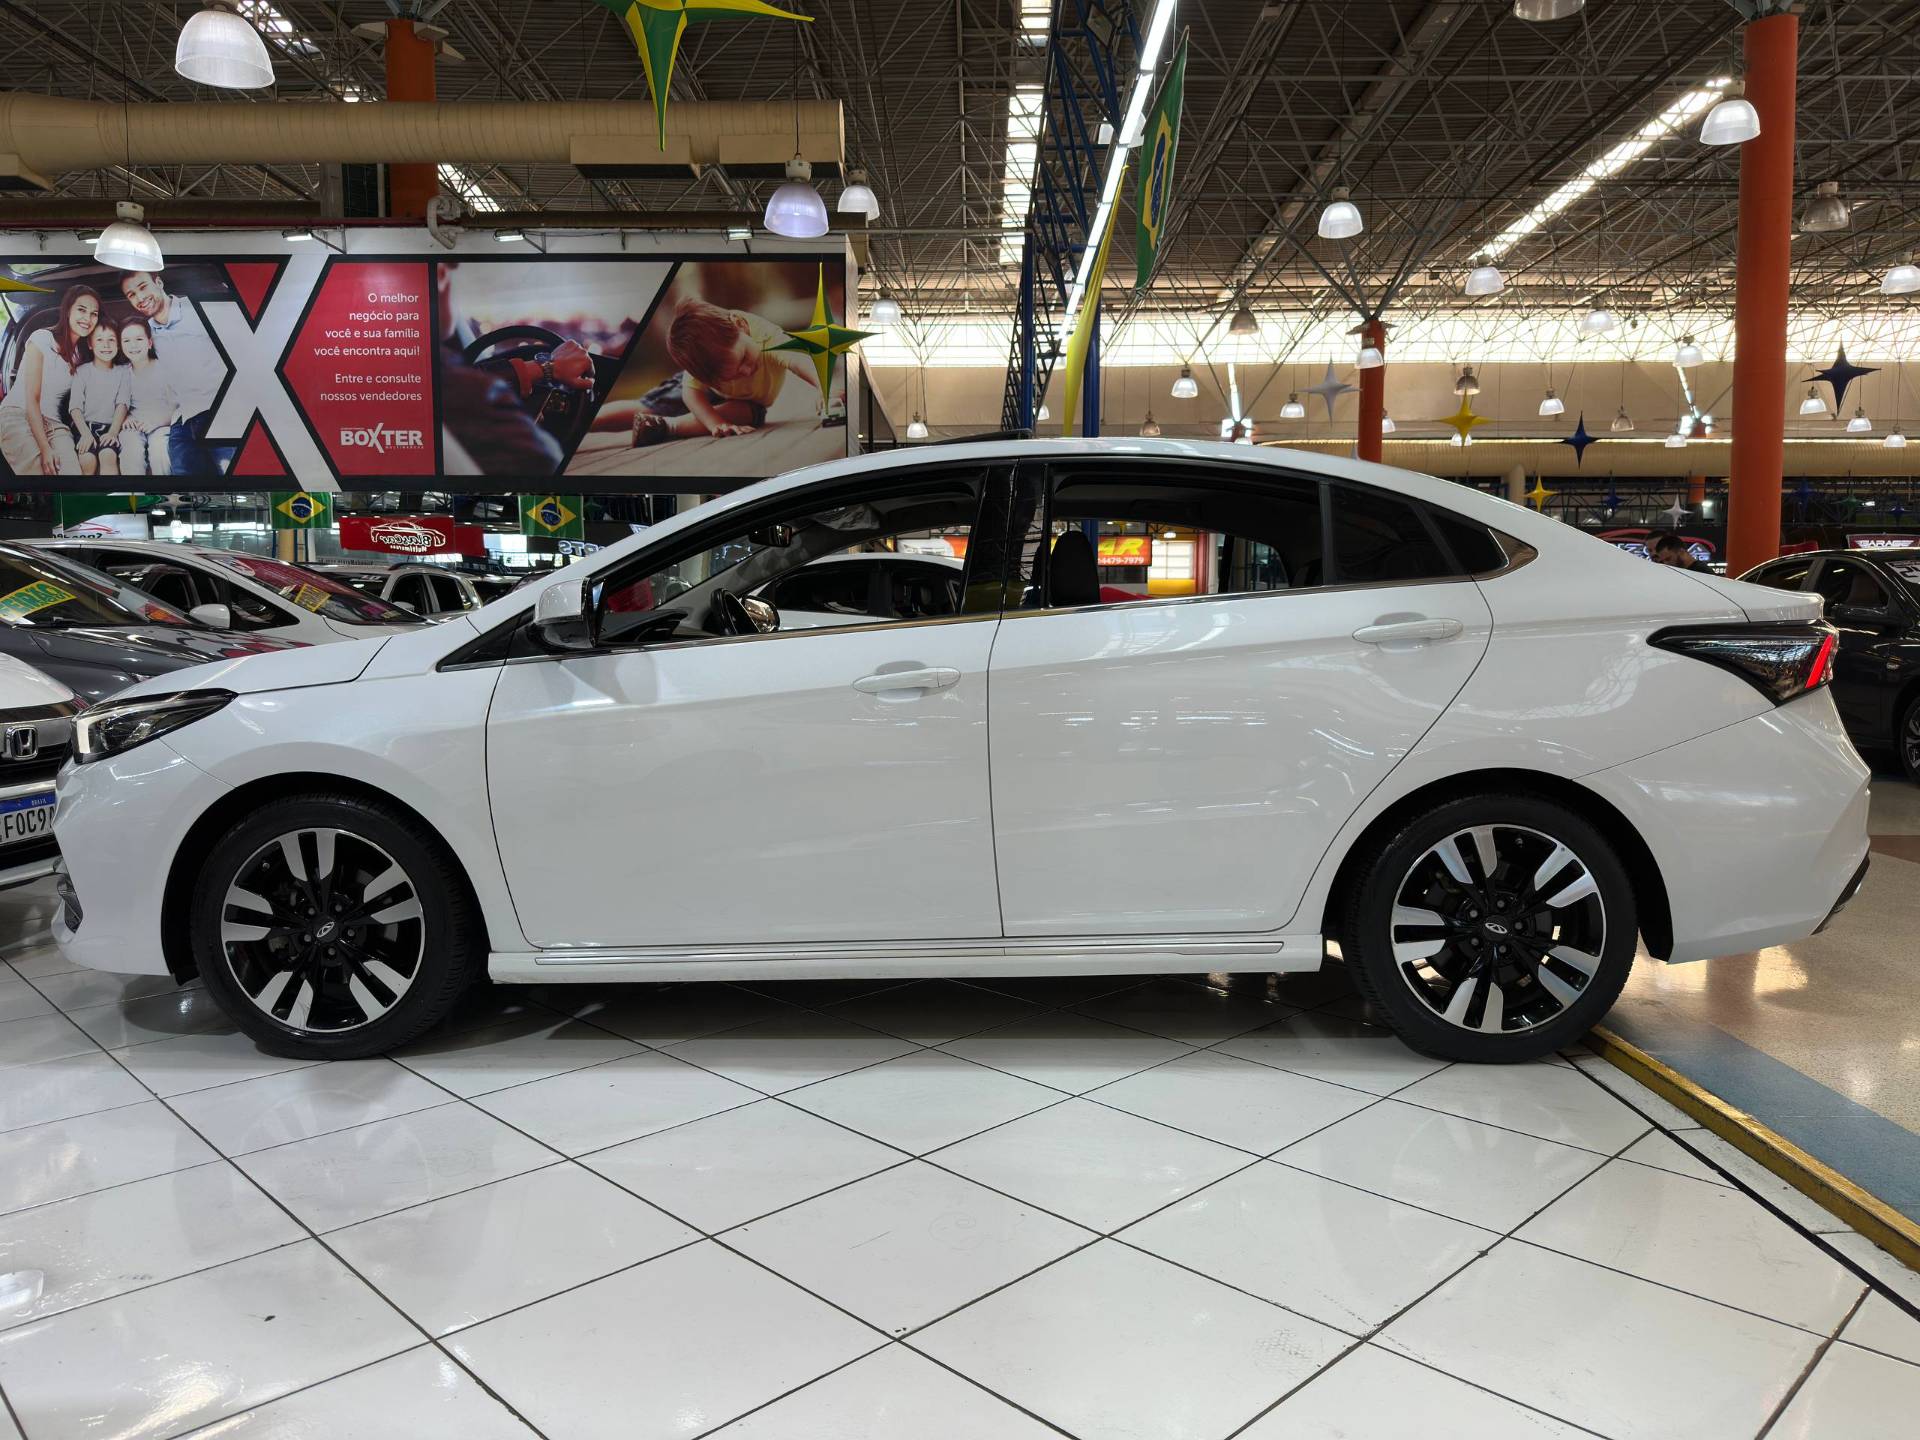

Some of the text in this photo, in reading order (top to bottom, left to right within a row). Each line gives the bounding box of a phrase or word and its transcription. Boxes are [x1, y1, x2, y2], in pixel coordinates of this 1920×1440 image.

[368, 293, 419, 303] O melhor
[349, 311, 419, 323] negócio para
[325, 328, 351, 338] você
[384, 328, 420, 338] família
[314, 346, 420, 358] você encontra aqui!
[335, 374, 421, 384] Entre e consulte
[320, 392, 422, 401] nossos vendedores
[340, 422, 423, 454] BOXTER
[1097, 557, 1144, 565] 4479-7979
